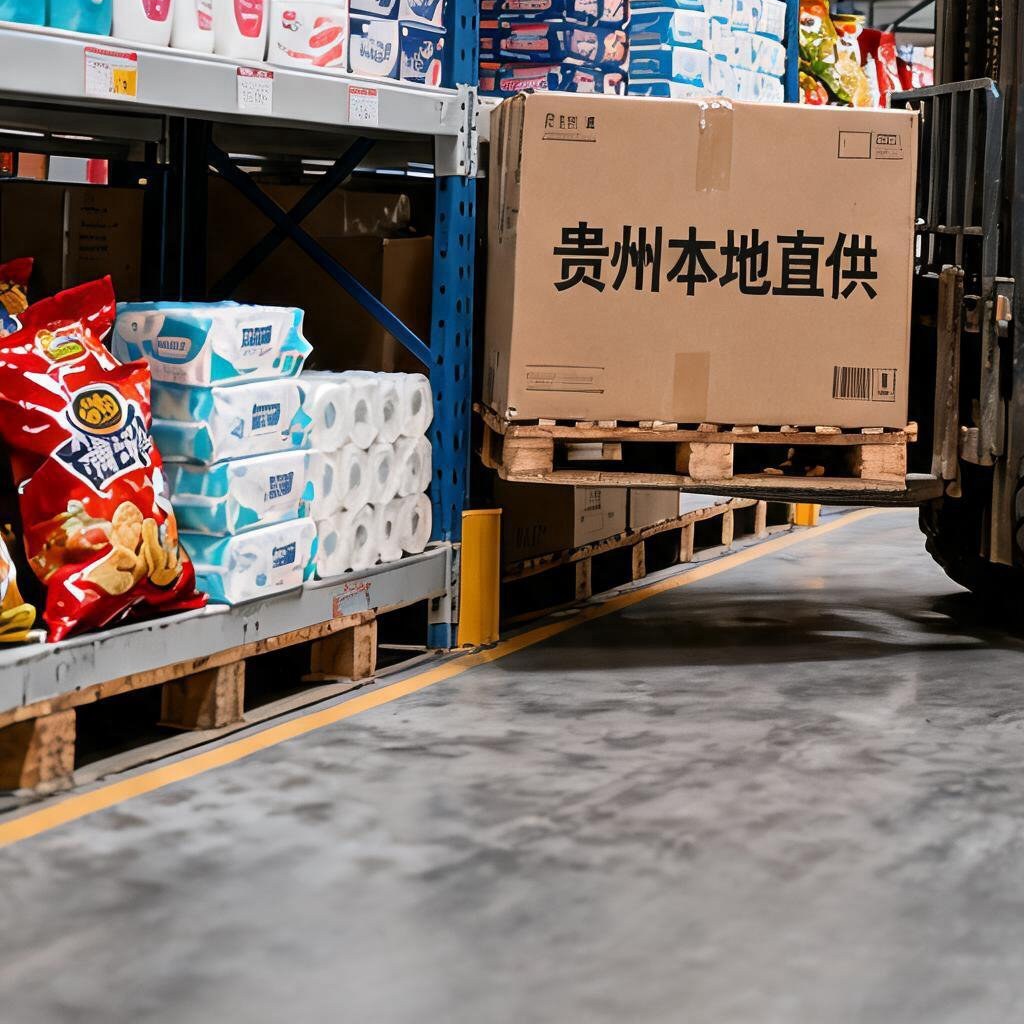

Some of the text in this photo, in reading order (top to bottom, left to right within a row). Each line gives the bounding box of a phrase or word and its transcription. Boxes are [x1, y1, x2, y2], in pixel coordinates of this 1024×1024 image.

[553, 221, 878, 300] 贵州本地直供
